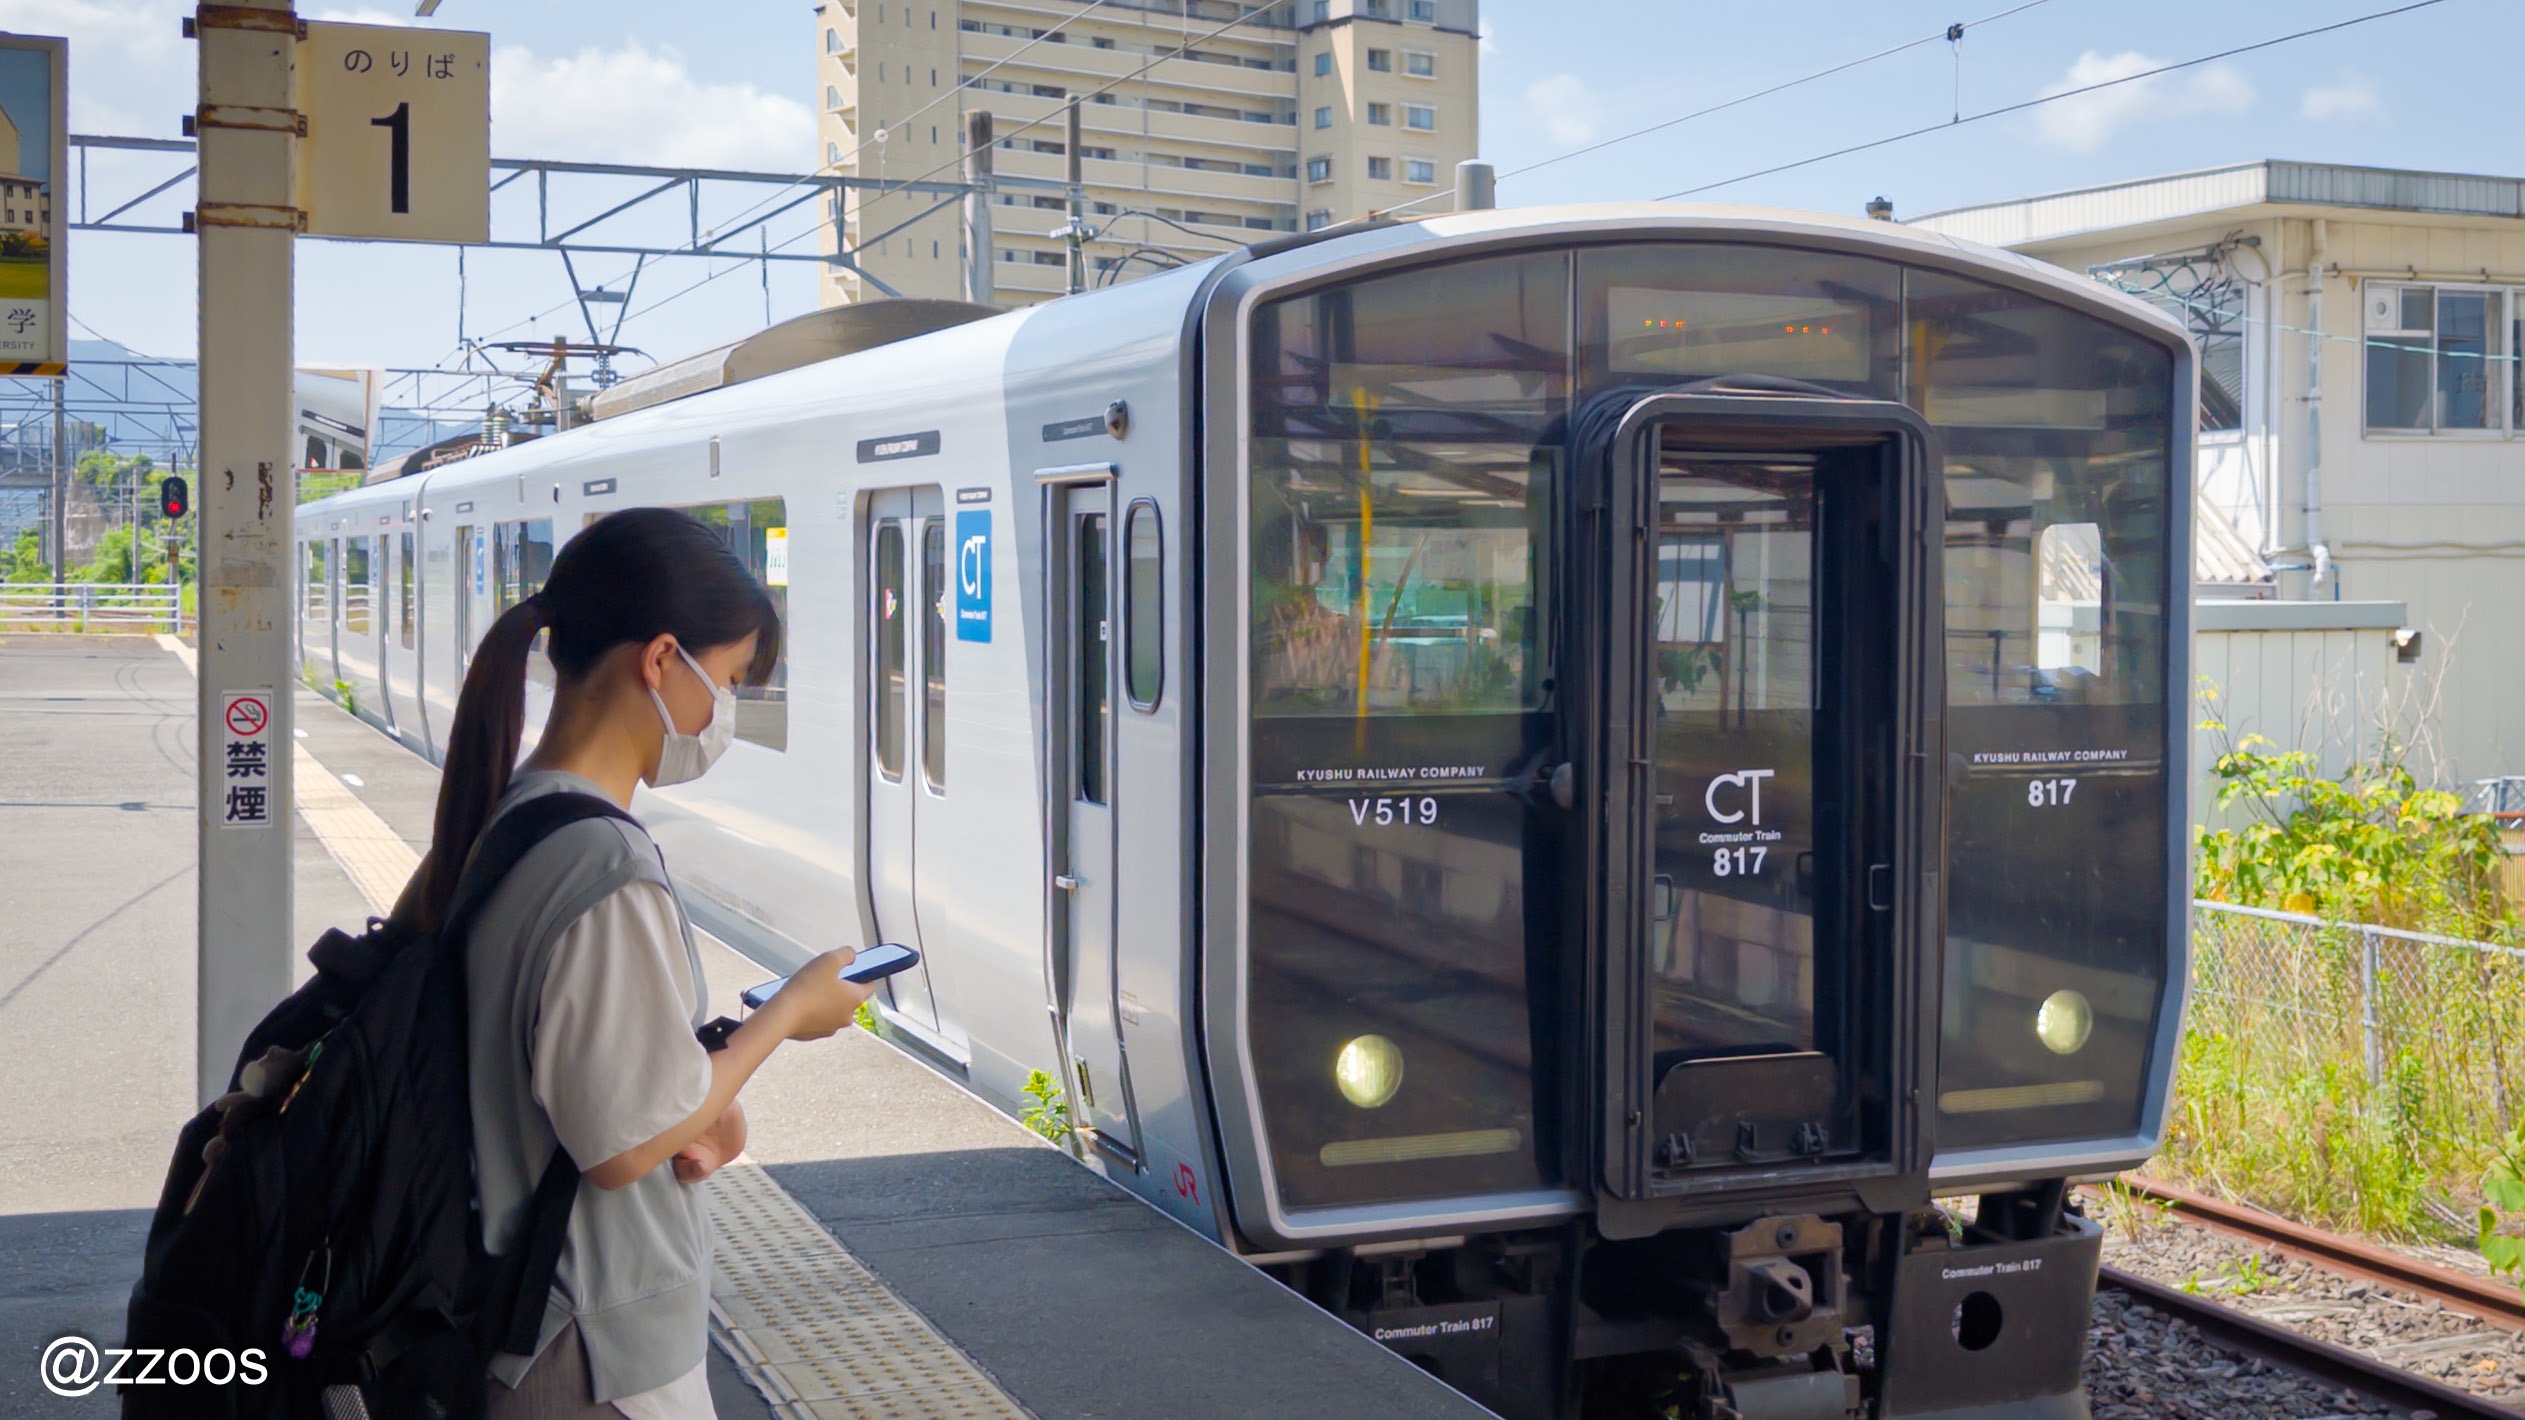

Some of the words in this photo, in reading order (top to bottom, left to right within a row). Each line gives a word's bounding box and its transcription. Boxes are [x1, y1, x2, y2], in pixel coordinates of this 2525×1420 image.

[345, 50, 455, 79] のりば
[371, 102, 409, 213] 1
[961, 535, 986, 599] CT
[1974, 752, 2020, 763] KYUSHU
[2023, 751, 2071, 762] RAILWAY
[2074, 749, 2128, 760] COMPANY
[226, 741, 266, 821] 禁煙
[1297, 769, 1353, 781] KYUSHU
[1357, 768, 1416, 779] RAILWAY
[1420, 766, 1485, 778] COMPANY
[1705, 769, 1775, 825] CT
[2028, 778, 2077, 807] 817
[1348, 797, 1438, 827] V519
[1699, 831, 1753, 844] Commuter
[1755, 830, 1781, 841] Train
[1713, 846, 1768, 877] 817
[1173, 1161, 1200, 1207] JR
[1942, 1265, 1994, 1279] Commuter
[1995, 1262, 2021, 1274] Train
[2022, 1259, 2042, 1271] 817
[1375, 1324, 1438, 1340] Commuter
[1440, 1319, 1470, 1333] Train
[1471, 1316, 1494, 1330] 817
